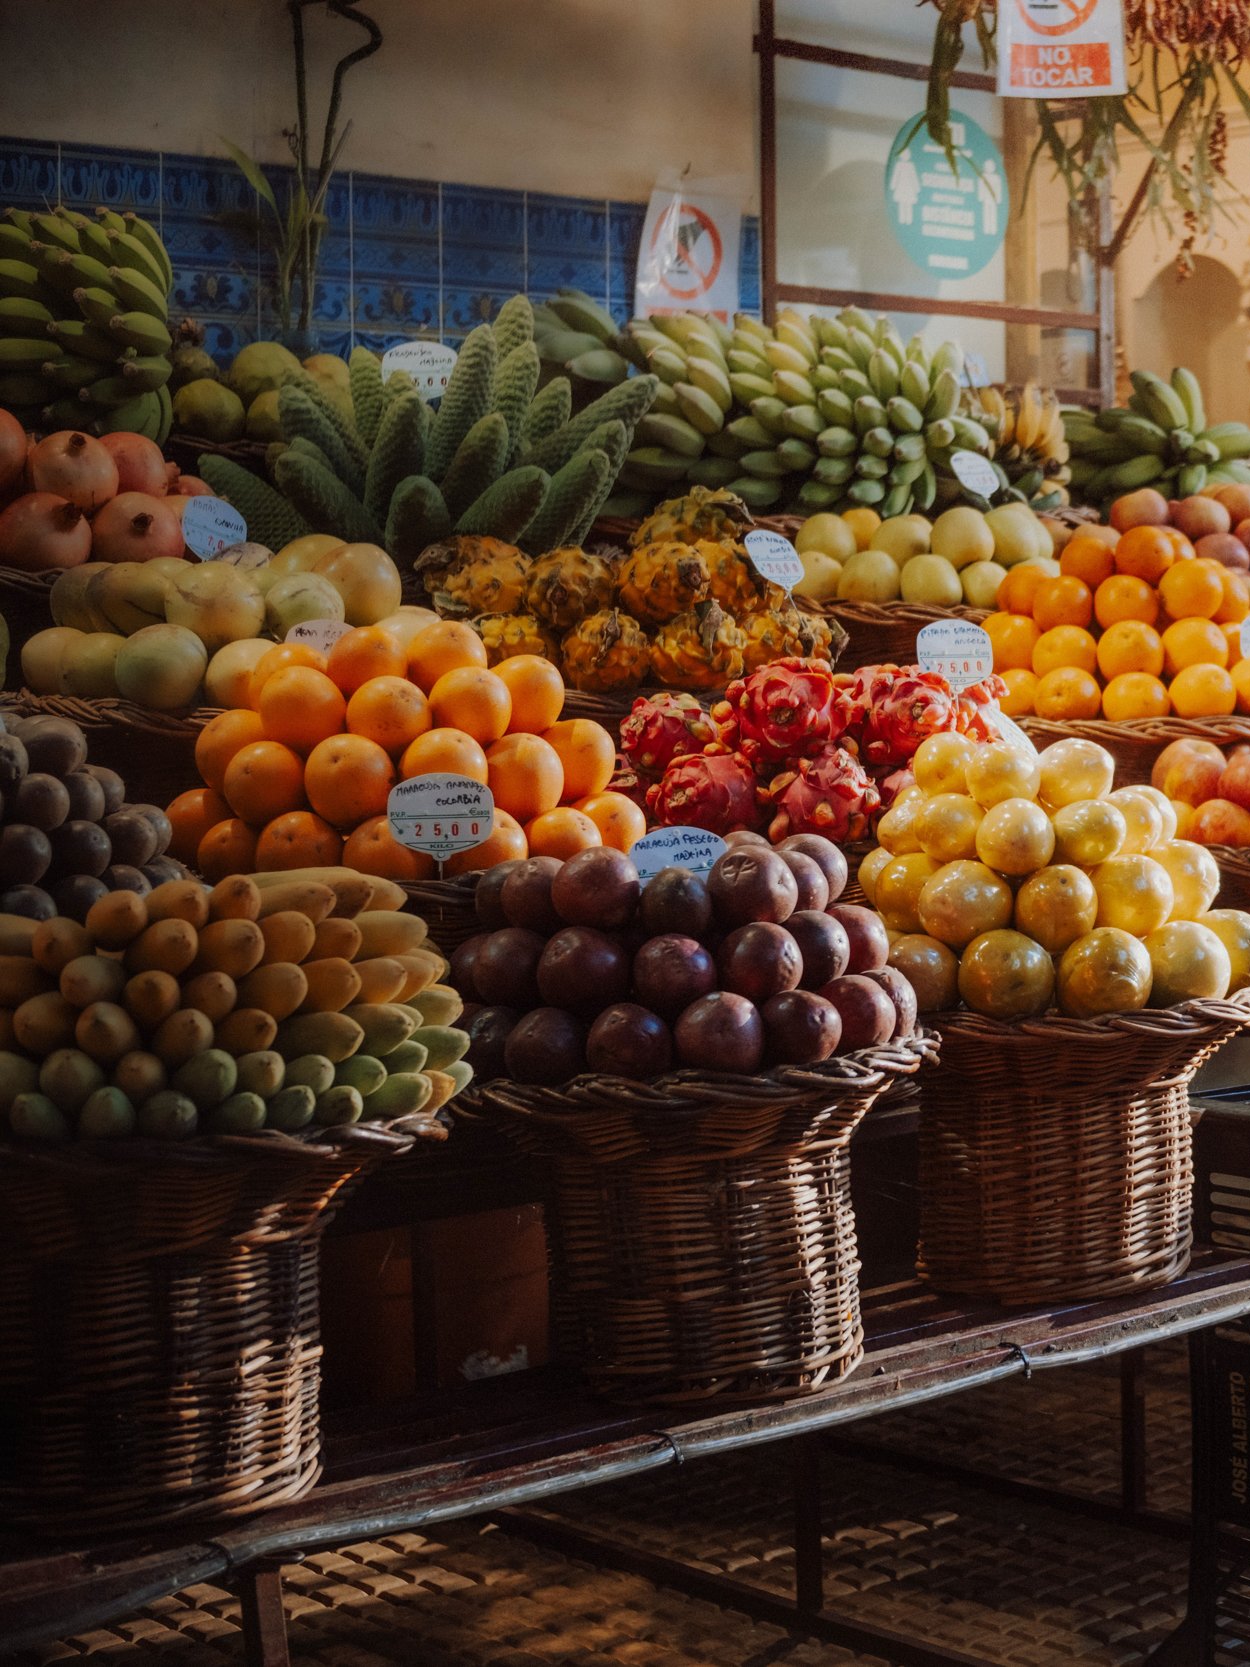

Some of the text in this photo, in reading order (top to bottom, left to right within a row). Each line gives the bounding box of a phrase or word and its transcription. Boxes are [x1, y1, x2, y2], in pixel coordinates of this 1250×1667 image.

[1038, 46, 1072, 65] NO
[1022, 67, 1094, 86] TOCAR
[415, 822, 479, 841] 25,00
[1229, 1371, 1248, 1504] JOSÉ ALBERTO
